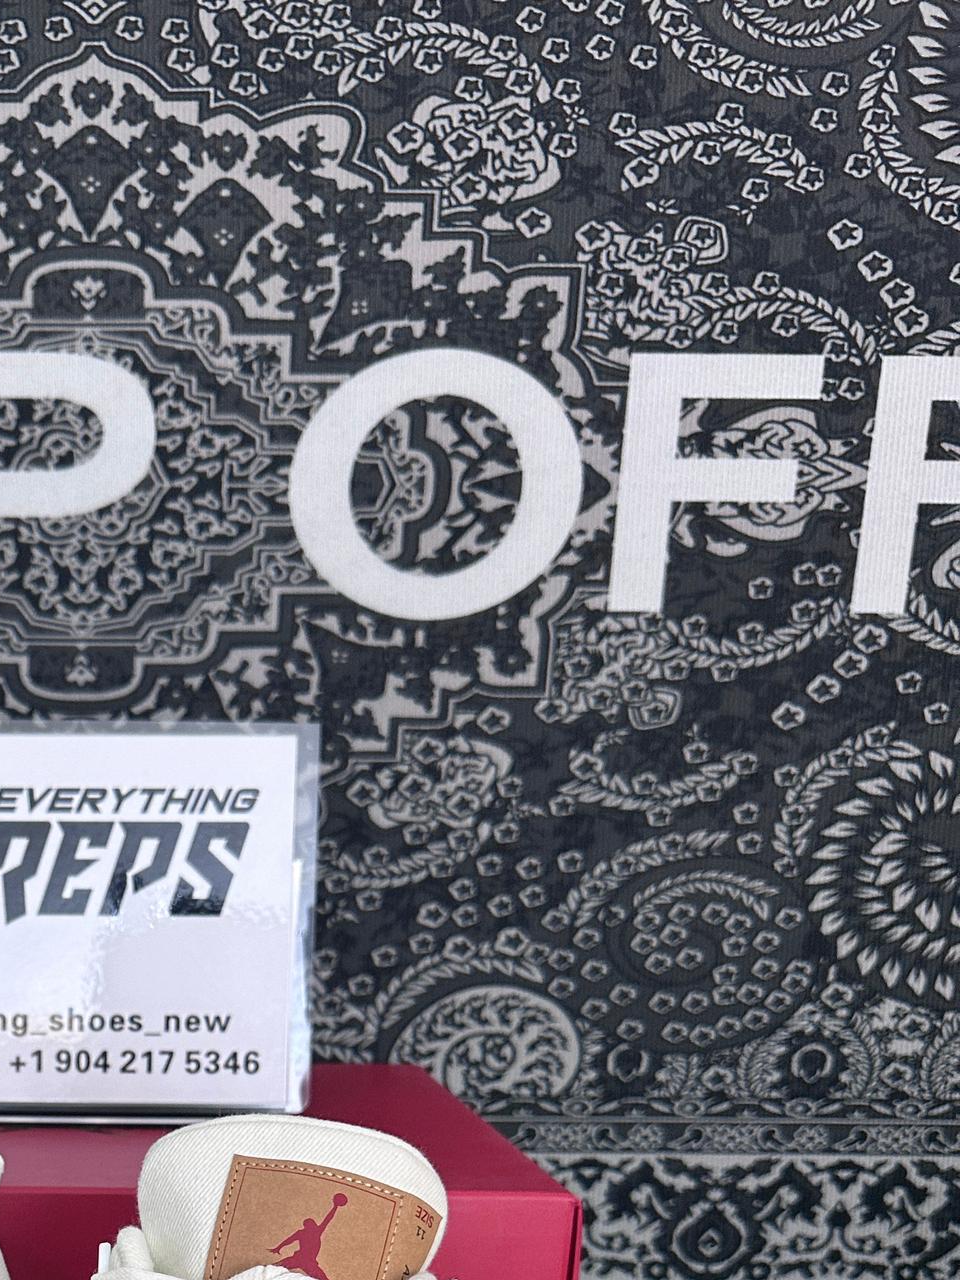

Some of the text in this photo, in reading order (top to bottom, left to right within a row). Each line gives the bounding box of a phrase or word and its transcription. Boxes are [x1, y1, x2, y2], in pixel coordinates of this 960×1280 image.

[288, 348, 960, 621] OFF
[9, 1050, 43, 1073] +1
[55, 1050, 110, 1075] 904
[119, 1050, 175, 1075] 217
[184, 1050, 261, 1076] 5346
[415, 1205, 435, 1229] SIZE
